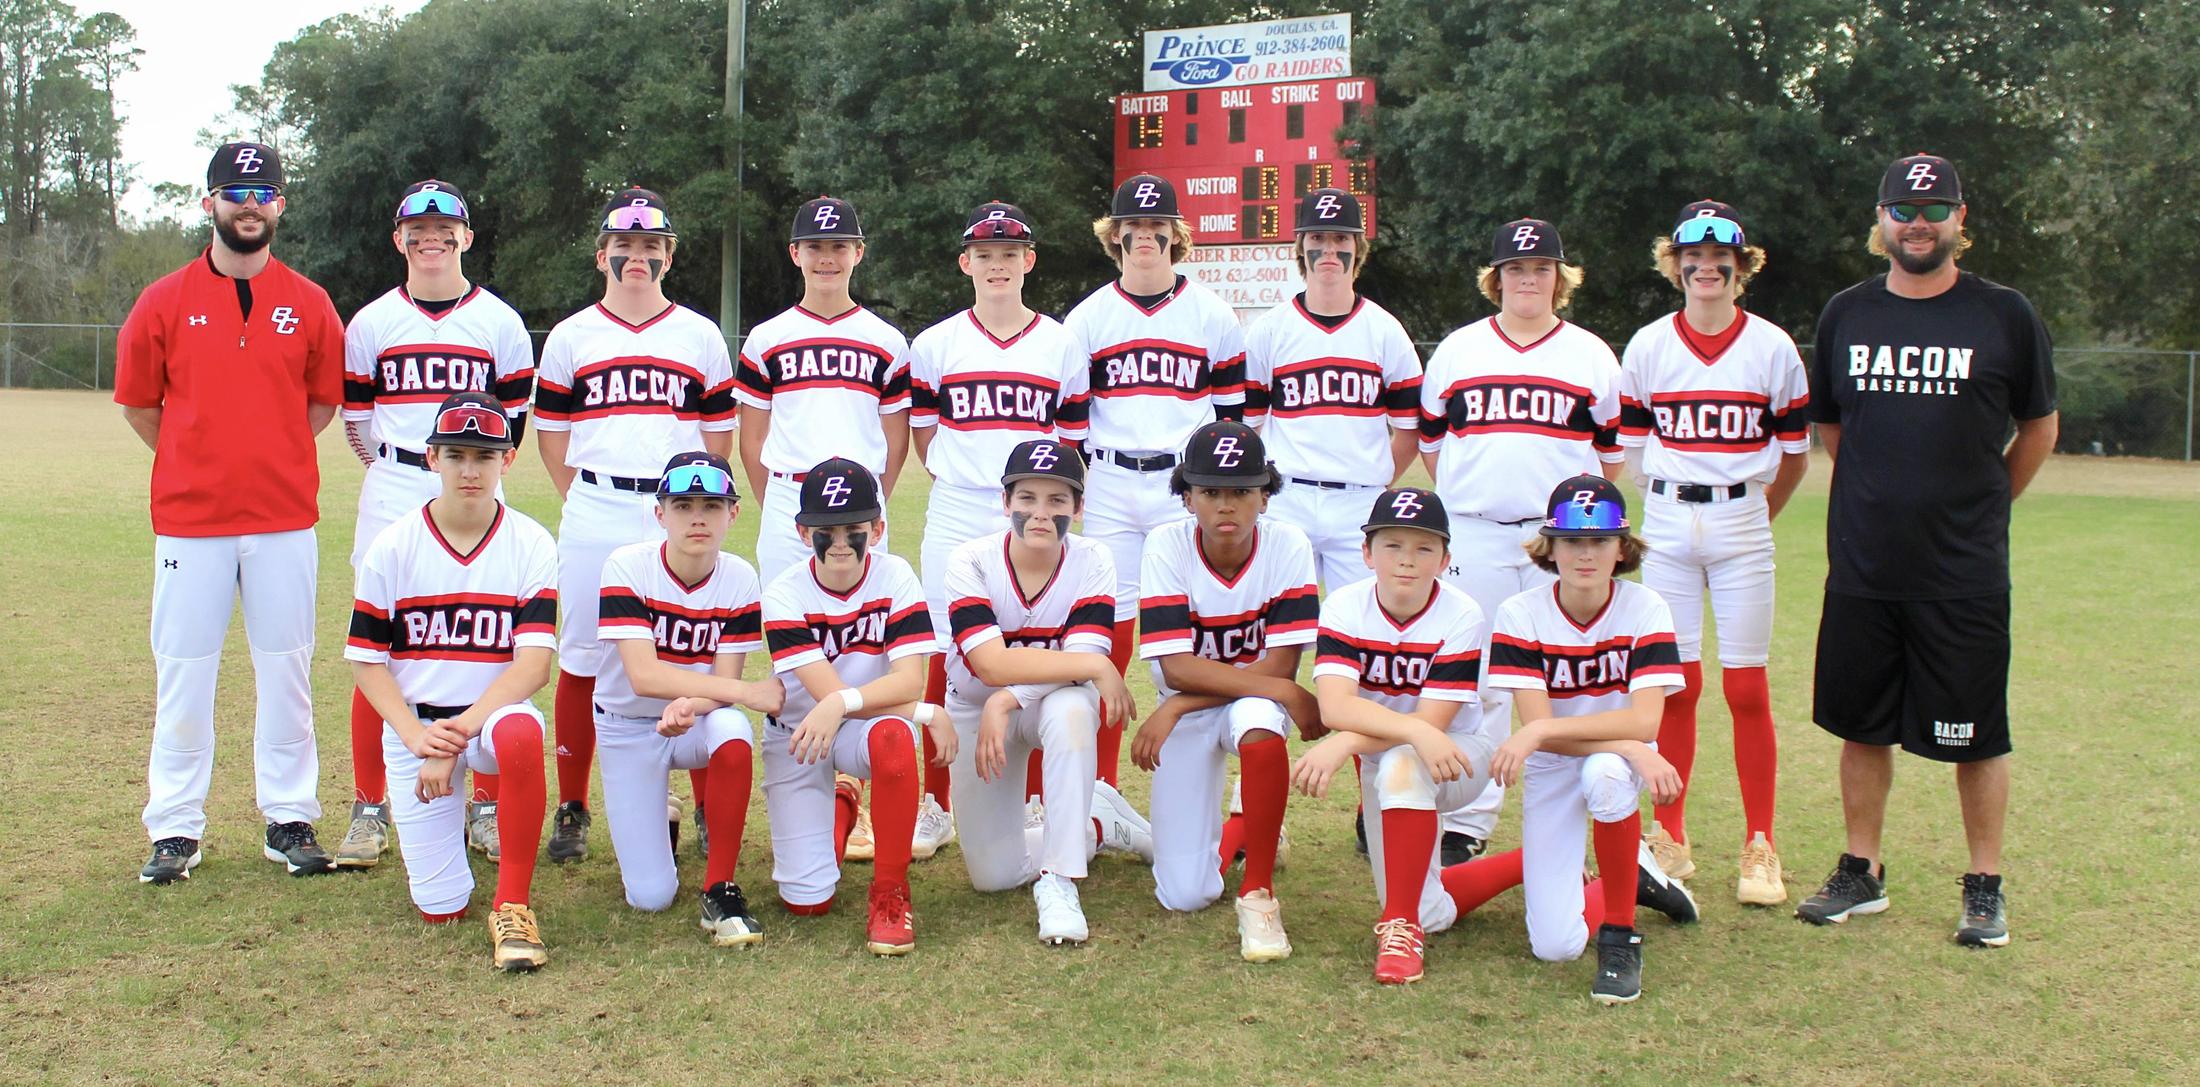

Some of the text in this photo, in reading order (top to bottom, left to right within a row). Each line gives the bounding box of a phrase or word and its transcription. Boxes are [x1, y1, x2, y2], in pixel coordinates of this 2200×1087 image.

[1265, 19, 1338, 37] DOUGLAS, GA.
[1158, 34, 1246, 60] PRINCE
[1255, 34, 1345, 57] 912-384-2600
[1181, 60, 1220, 82] Ford
[1235, 57, 1344, 82] GO RAIDERS
[1221, 89, 1253, 108] BALL
[1271, 84, 1319, 105] STRIKE
[1336, 82, 1365, 101] OUT
[1121, 95, 1168, 115] BATTER
[234, 148, 264, 174] BC
[1255, 149, 1264, 163] R
[1308, 146, 1318, 160] H
[1186, 176, 1237, 196] VISITOR
[1905, 163, 1938, 191] BC
[1134, 182, 1161, 208] BC
[1315, 195, 1342, 219] BC
[814, 205, 841, 231] BC
[1200, 213, 1237, 233] HOME
[1512, 225, 1540, 251] BC
[1229, 245, 1296, 262] RECYCL
[1198, 268, 1222, 283] 912
[270, 305, 300, 335] BC
[779, 348, 878, 382] BACON
[1848, 344, 1974, 379] BACON
[382, 357, 489, 392] BACON
[1856, 378, 1959, 395] BASEBALL
[585, 369, 690, 408] BACON
[1280, 370, 1382, 407] BACON
[949, 384, 1053, 423] BACON
[1464, 386, 1576, 427] BACON
[1029, 444, 1058, 470] BC
[1213, 436, 1244, 468] BC
[821, 476, 851, 508] BC
[1392, 491, 1424, 519] BC
[1934, 720, 1974, 738] BACON
[1936, 737, 1970, 747] BASEBALL
[362, 805, 381, 816] NIKE
